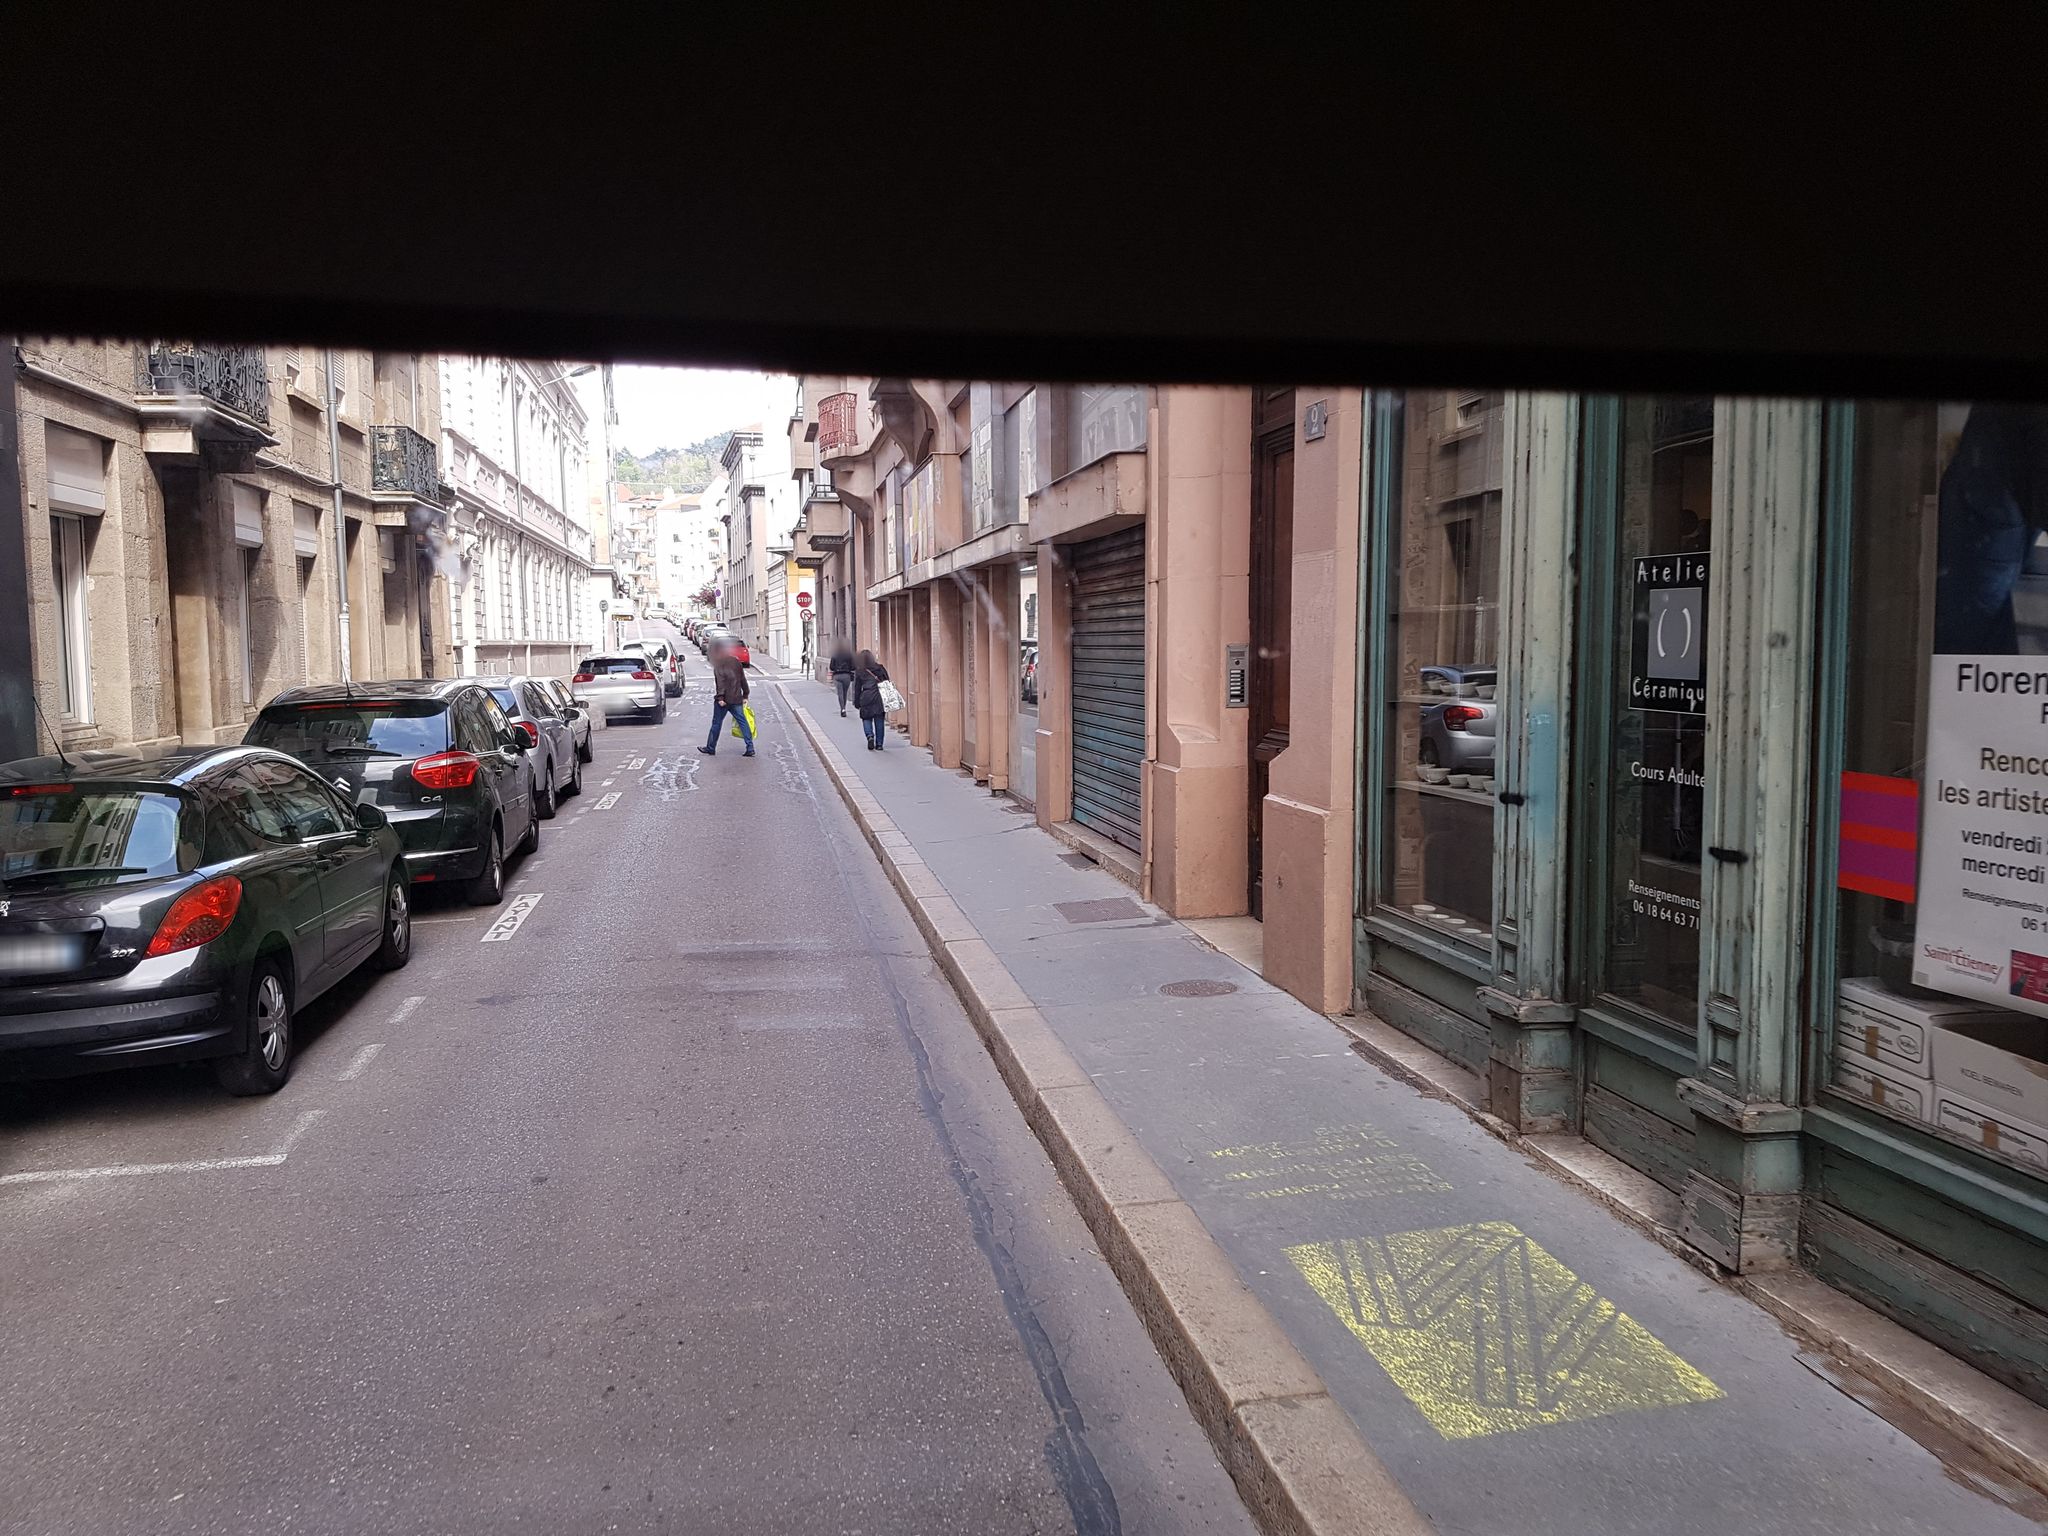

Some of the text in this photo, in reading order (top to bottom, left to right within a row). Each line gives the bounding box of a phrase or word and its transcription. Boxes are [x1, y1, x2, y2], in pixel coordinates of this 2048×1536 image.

[1637, 557, 1705, 584] Atelie
[1632, 675, 1705, 712] Céramiqu
[1631, 761, 1665, 781] Cours
[421, 795, 443, 803] C4
[1938, 779, 1970, 805] les
[1961, 829, 2043, 855] vendredi
[1962, 856, 2045, 885] mercredi
[1628, 879, 1701, 910] Renseignements
[1962, 888, 2044, 914] Renseignements
[489, 894, 538, 940] PAYANT
[1633, 899, 1644, 914] 06
[1647, 903, 1658, 918] 18
[1660, 907, 1672, 922] 64
[1674, 911, 1686, 926] 63
[2021, 916, 2038, 931] 06
[112, 948, 137, 958] 207
